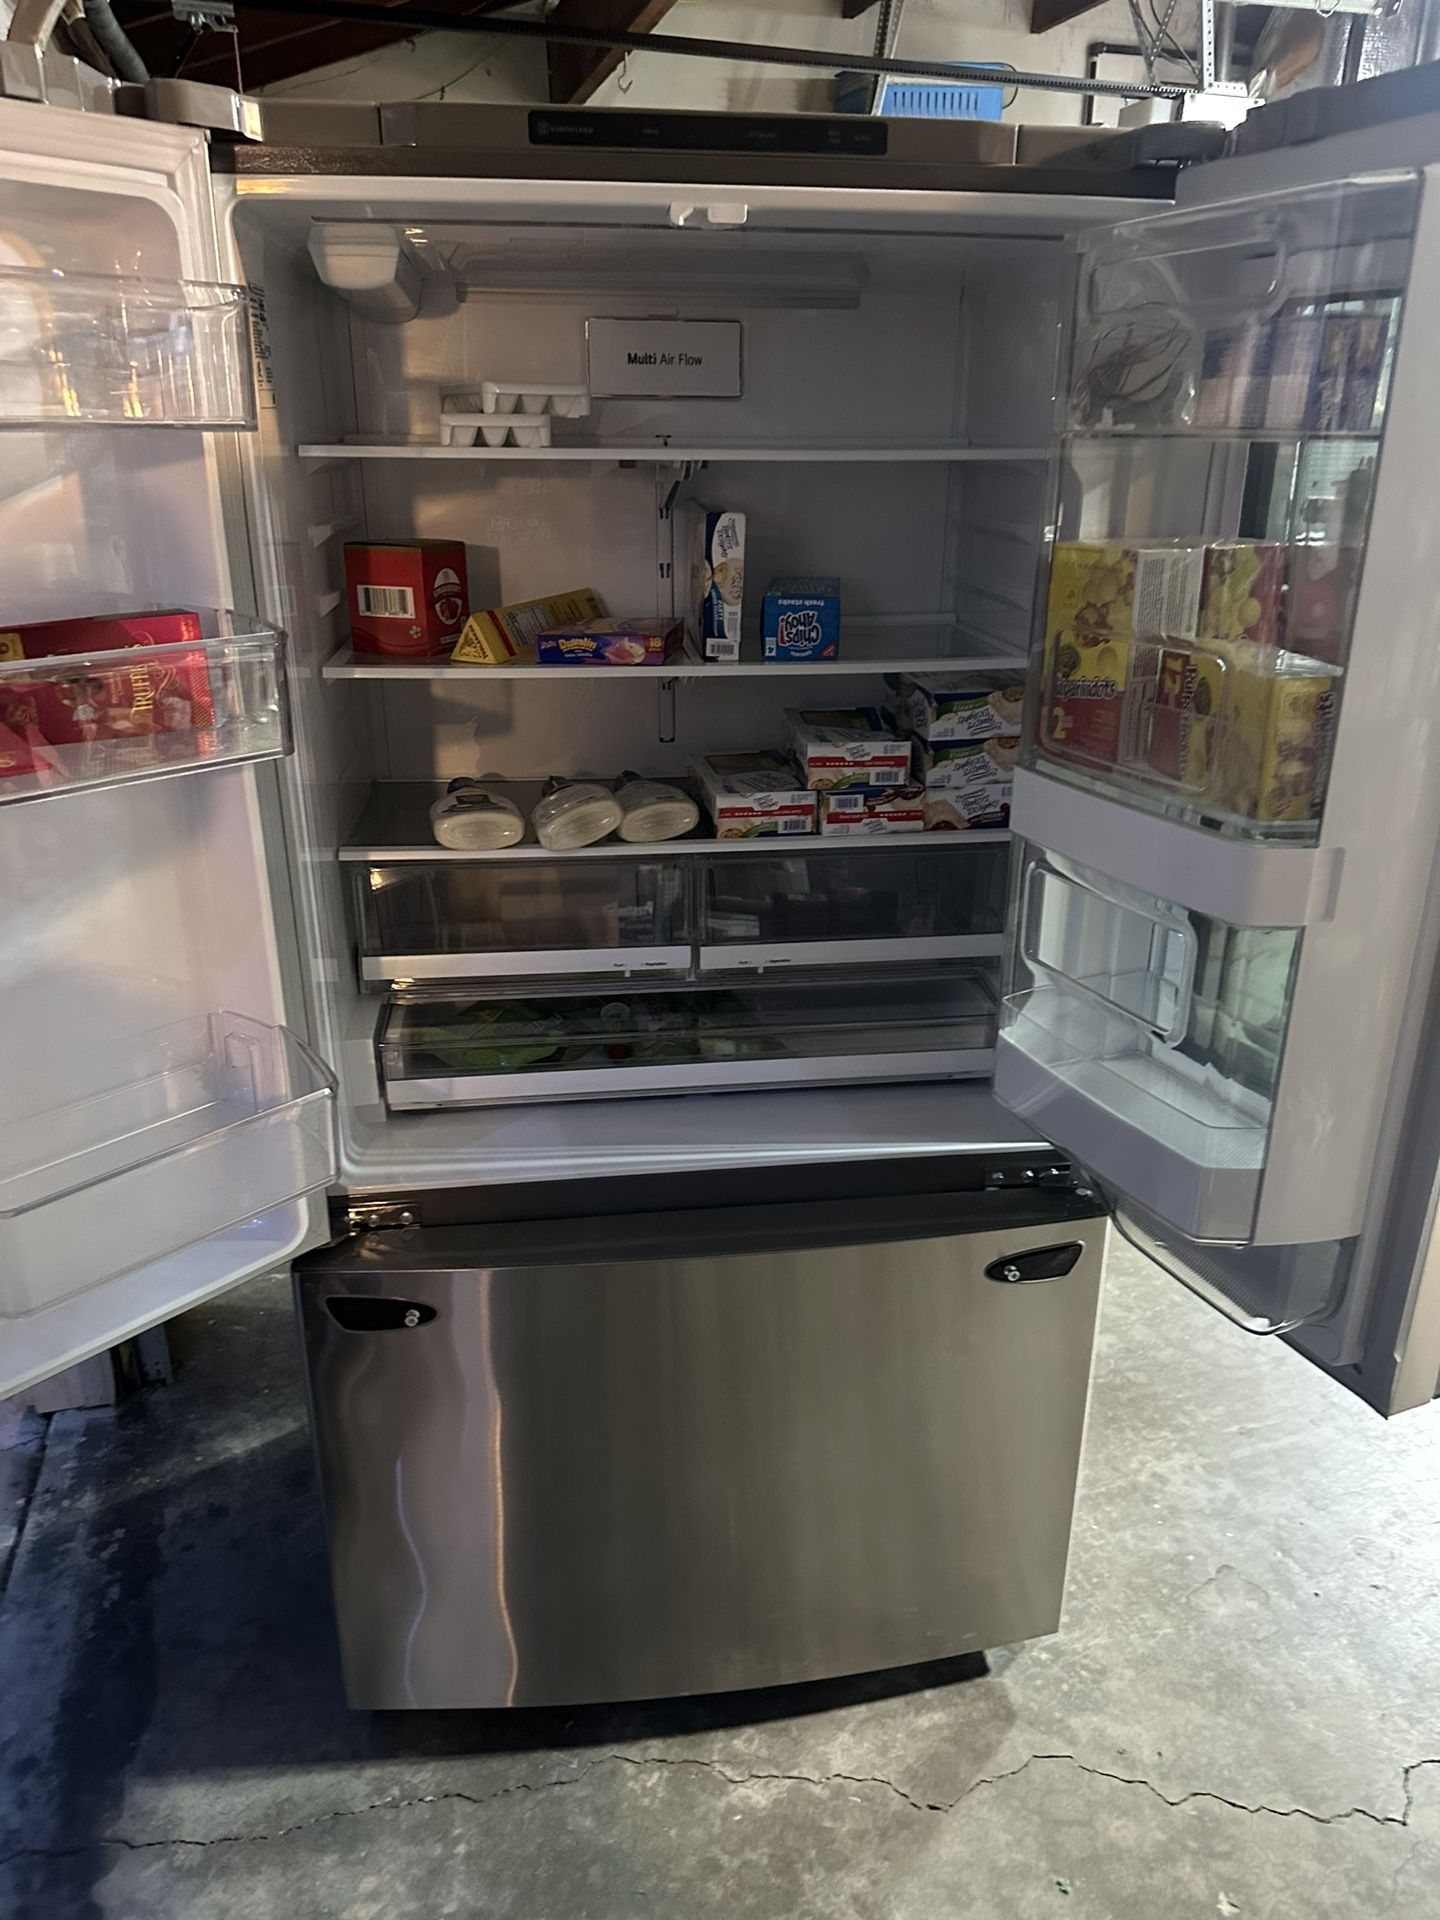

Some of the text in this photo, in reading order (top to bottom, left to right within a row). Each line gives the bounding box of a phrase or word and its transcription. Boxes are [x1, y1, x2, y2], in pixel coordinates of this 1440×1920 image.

[627, 353, 703, 366] Multi Air Flow
[785, 625, 820, 646] Chips
